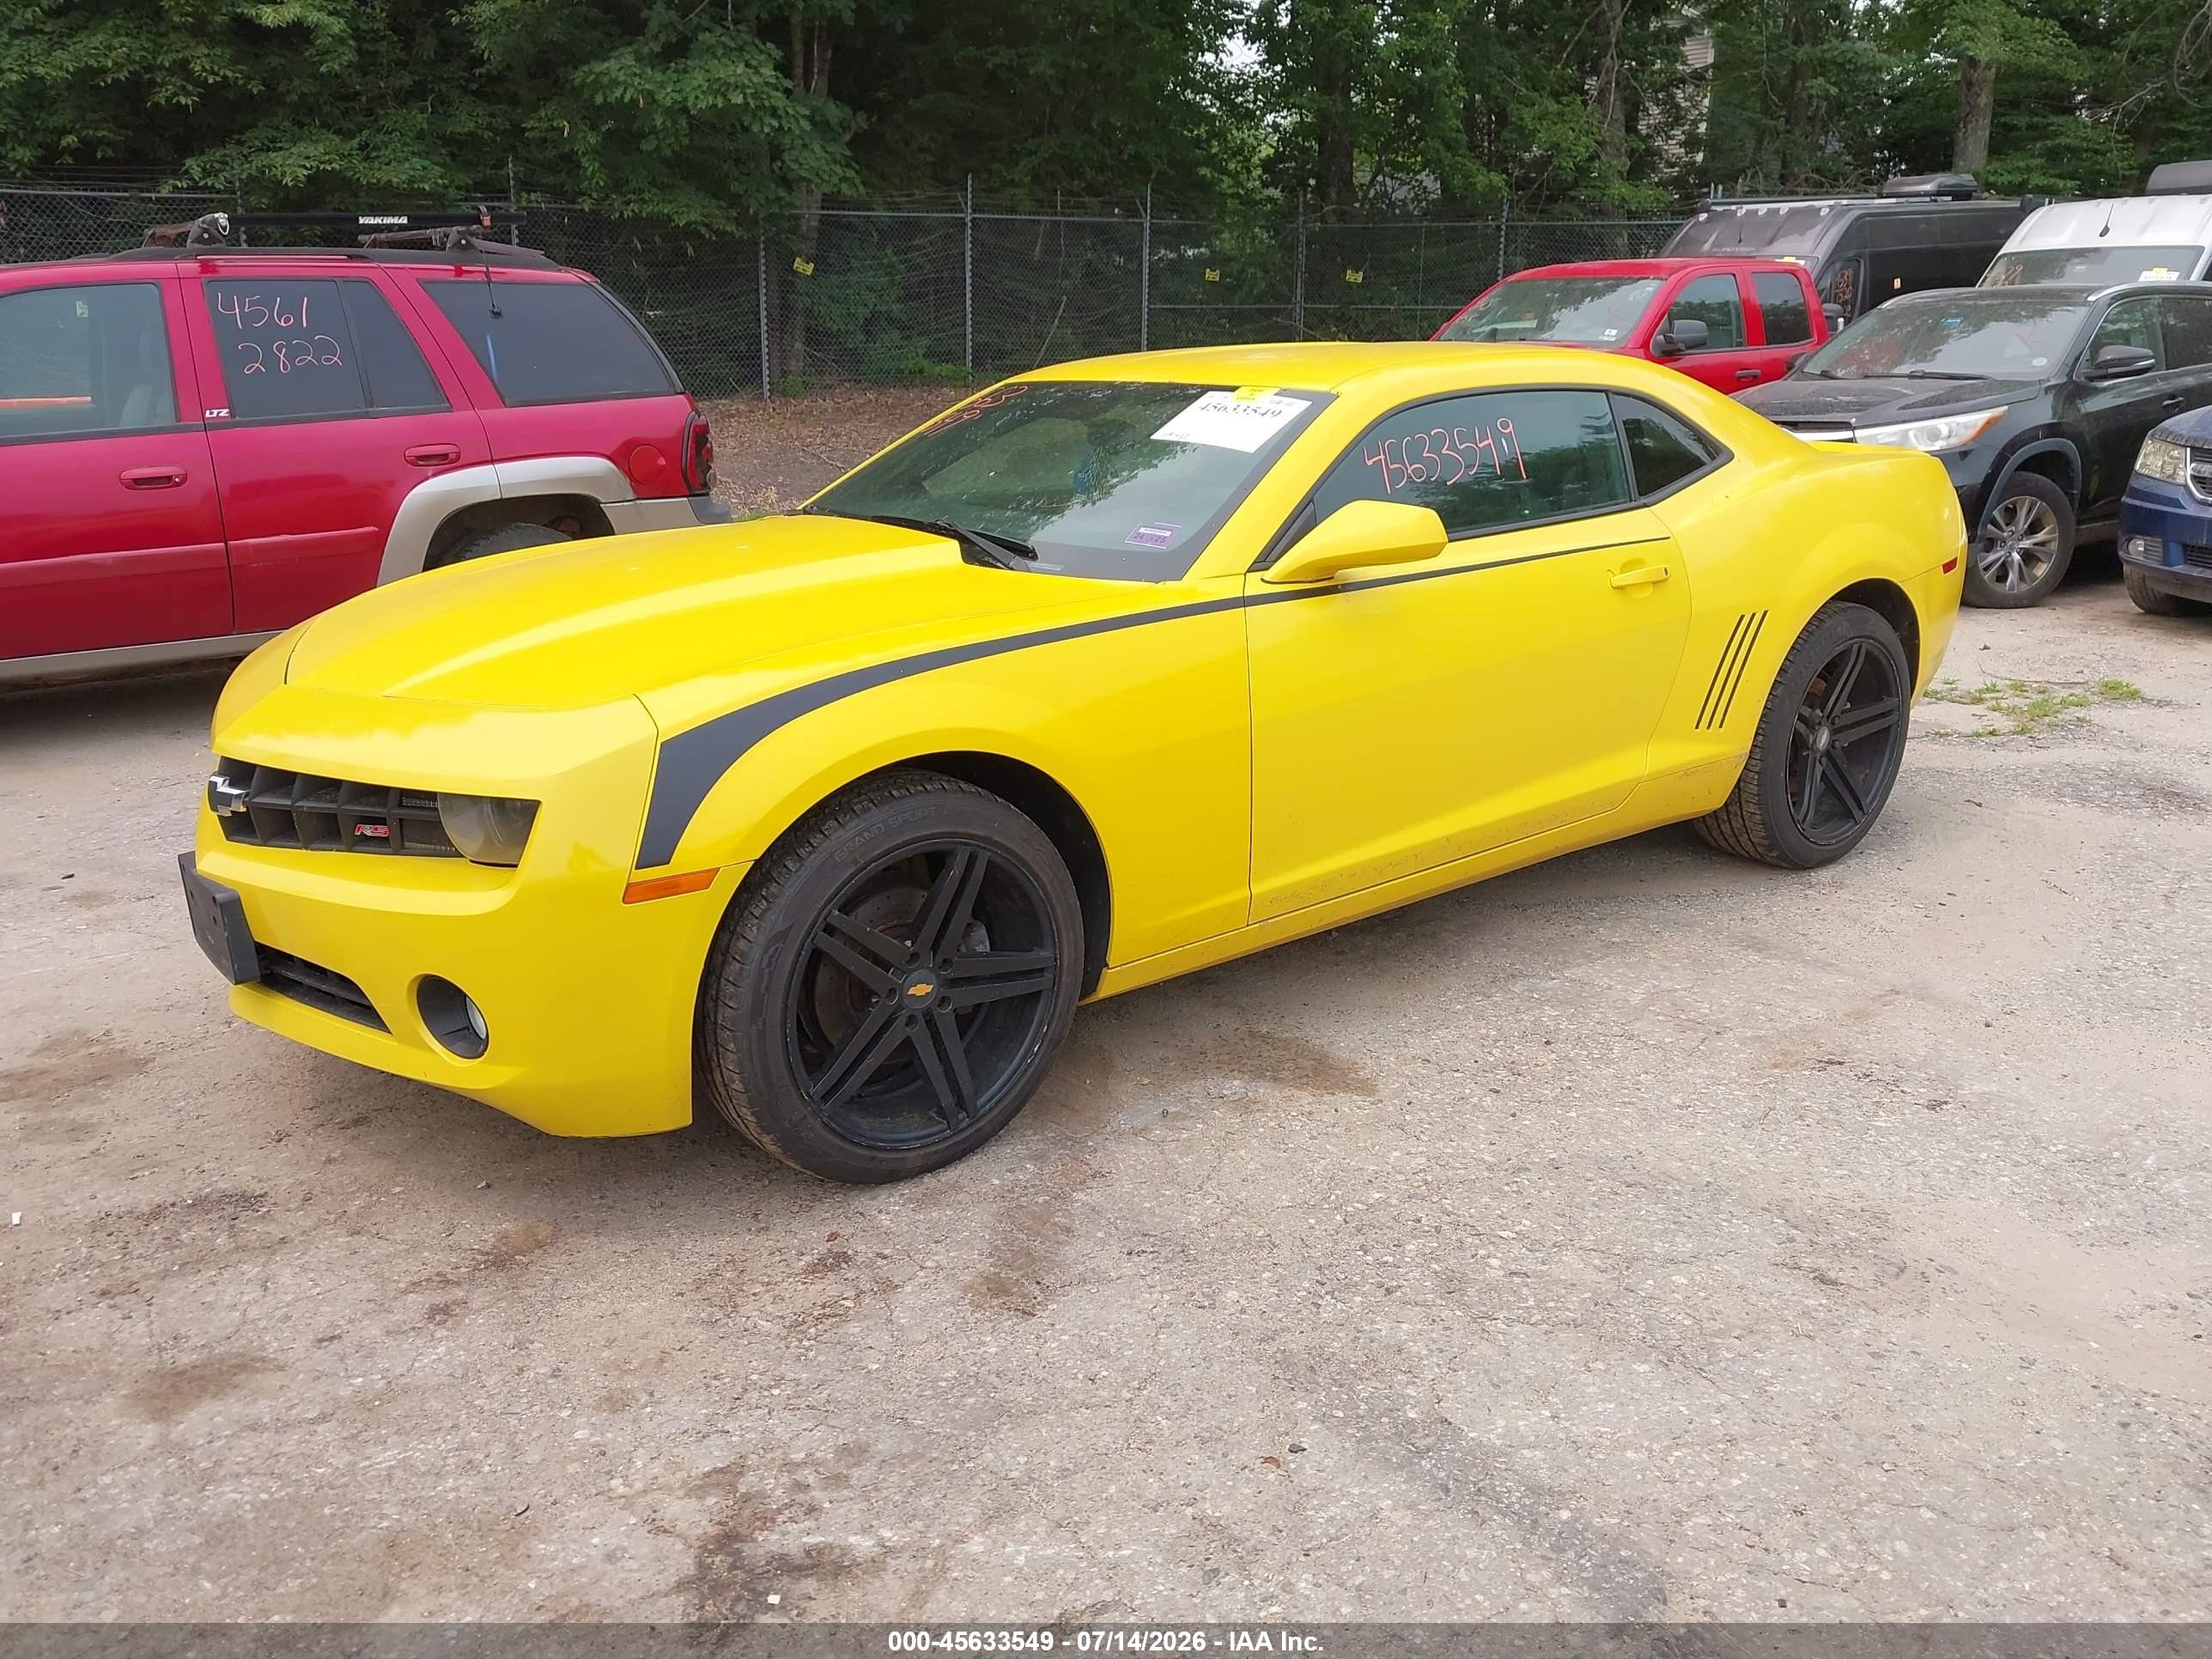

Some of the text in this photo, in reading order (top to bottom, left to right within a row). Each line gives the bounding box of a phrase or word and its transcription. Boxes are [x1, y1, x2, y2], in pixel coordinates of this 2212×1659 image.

[358, 216, 408, 224] YAKIMA
[217, 292, 309, 330] 4561
[238, 335, 343, 374] 2822
[205, 408, 230, 417] LTZ
[1363, 417, 1528, 495] 45633549
[890, 807, 937, 828] SPORT
[354, 824, 390, 837] RS
